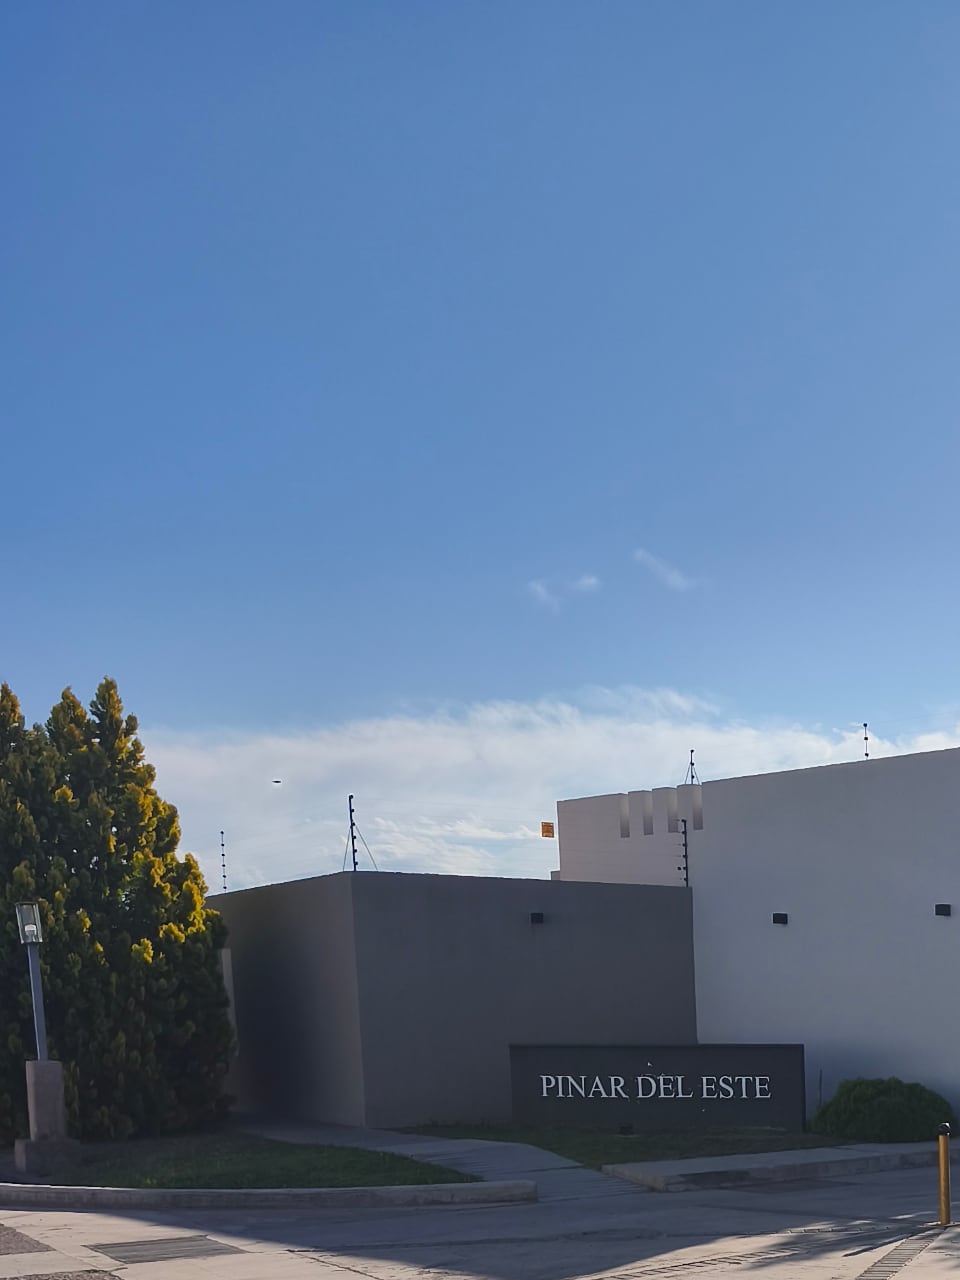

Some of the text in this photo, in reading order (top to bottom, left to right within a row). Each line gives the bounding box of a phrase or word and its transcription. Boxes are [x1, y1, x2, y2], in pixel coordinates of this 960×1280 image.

[540, 1075, 772, 1098] PINAR DEL ESTE
